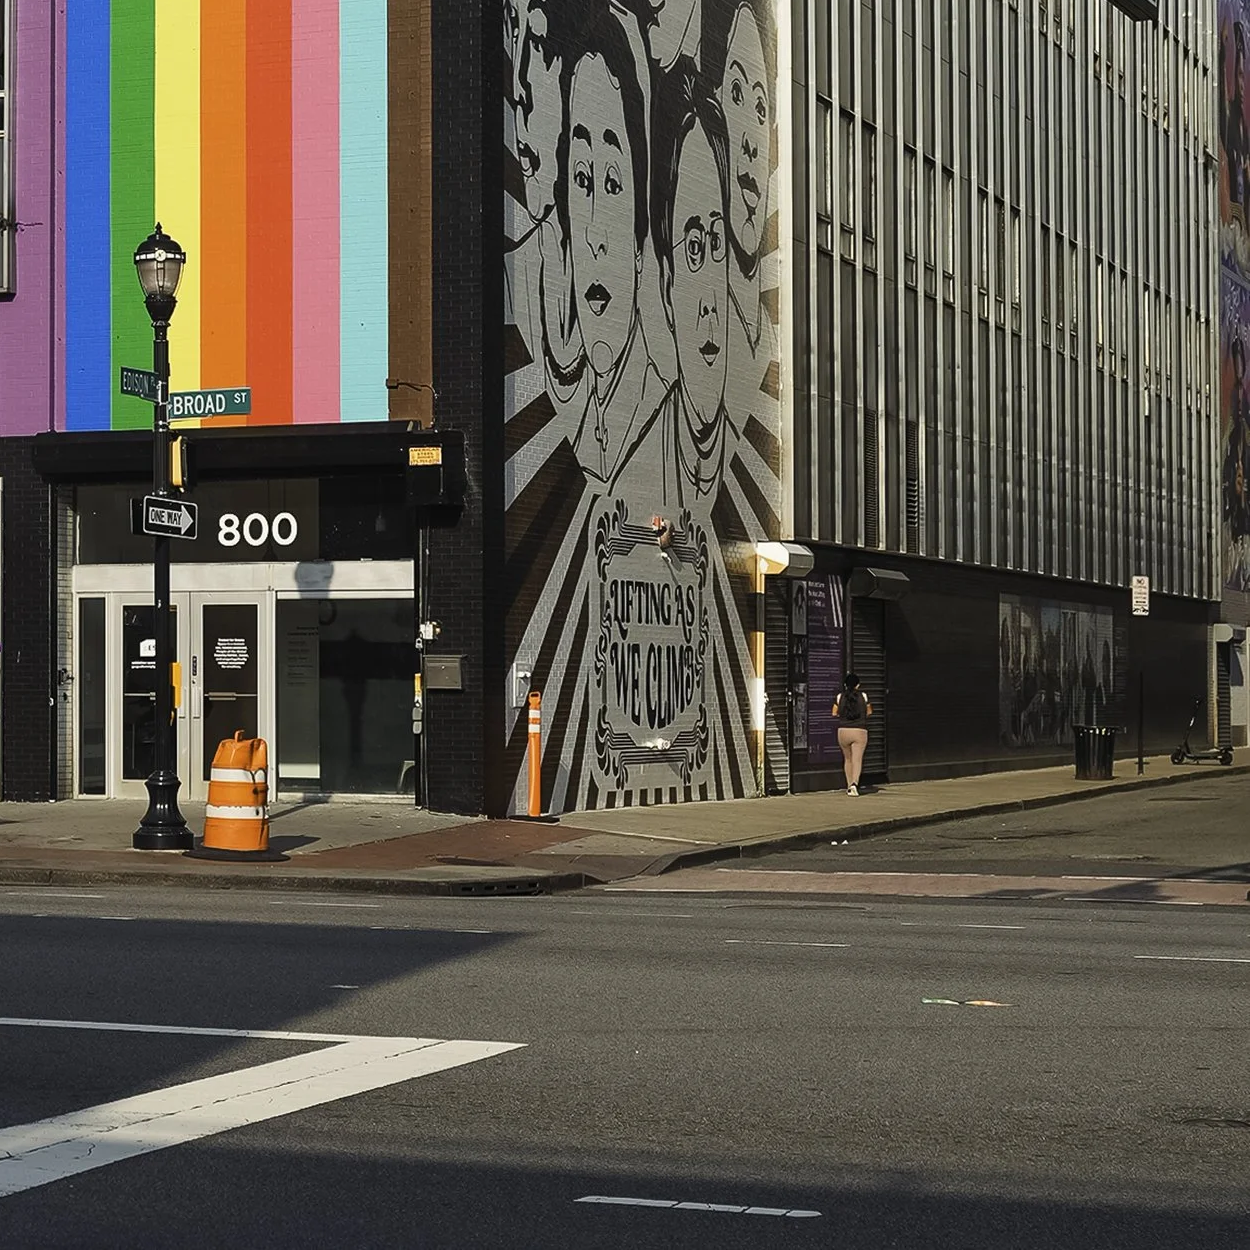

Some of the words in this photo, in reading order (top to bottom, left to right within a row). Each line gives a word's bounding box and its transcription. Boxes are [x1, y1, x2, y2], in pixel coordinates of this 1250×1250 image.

[123, 371, 149, 394] EDISON
[173, 394, 226, 415] BROAD
[234, 392, 247, 404] ST
[150, 508, 165, 524] ONE
[166, 511, 183, 525] WAY
[218, 512, 298, 547] 800
[610, 579, 671, 641] LIFTING
[675, 584, 696, 645] AS
[611, 643, 641, 727] WE
[645, 642, 697, 730] CLIMB
